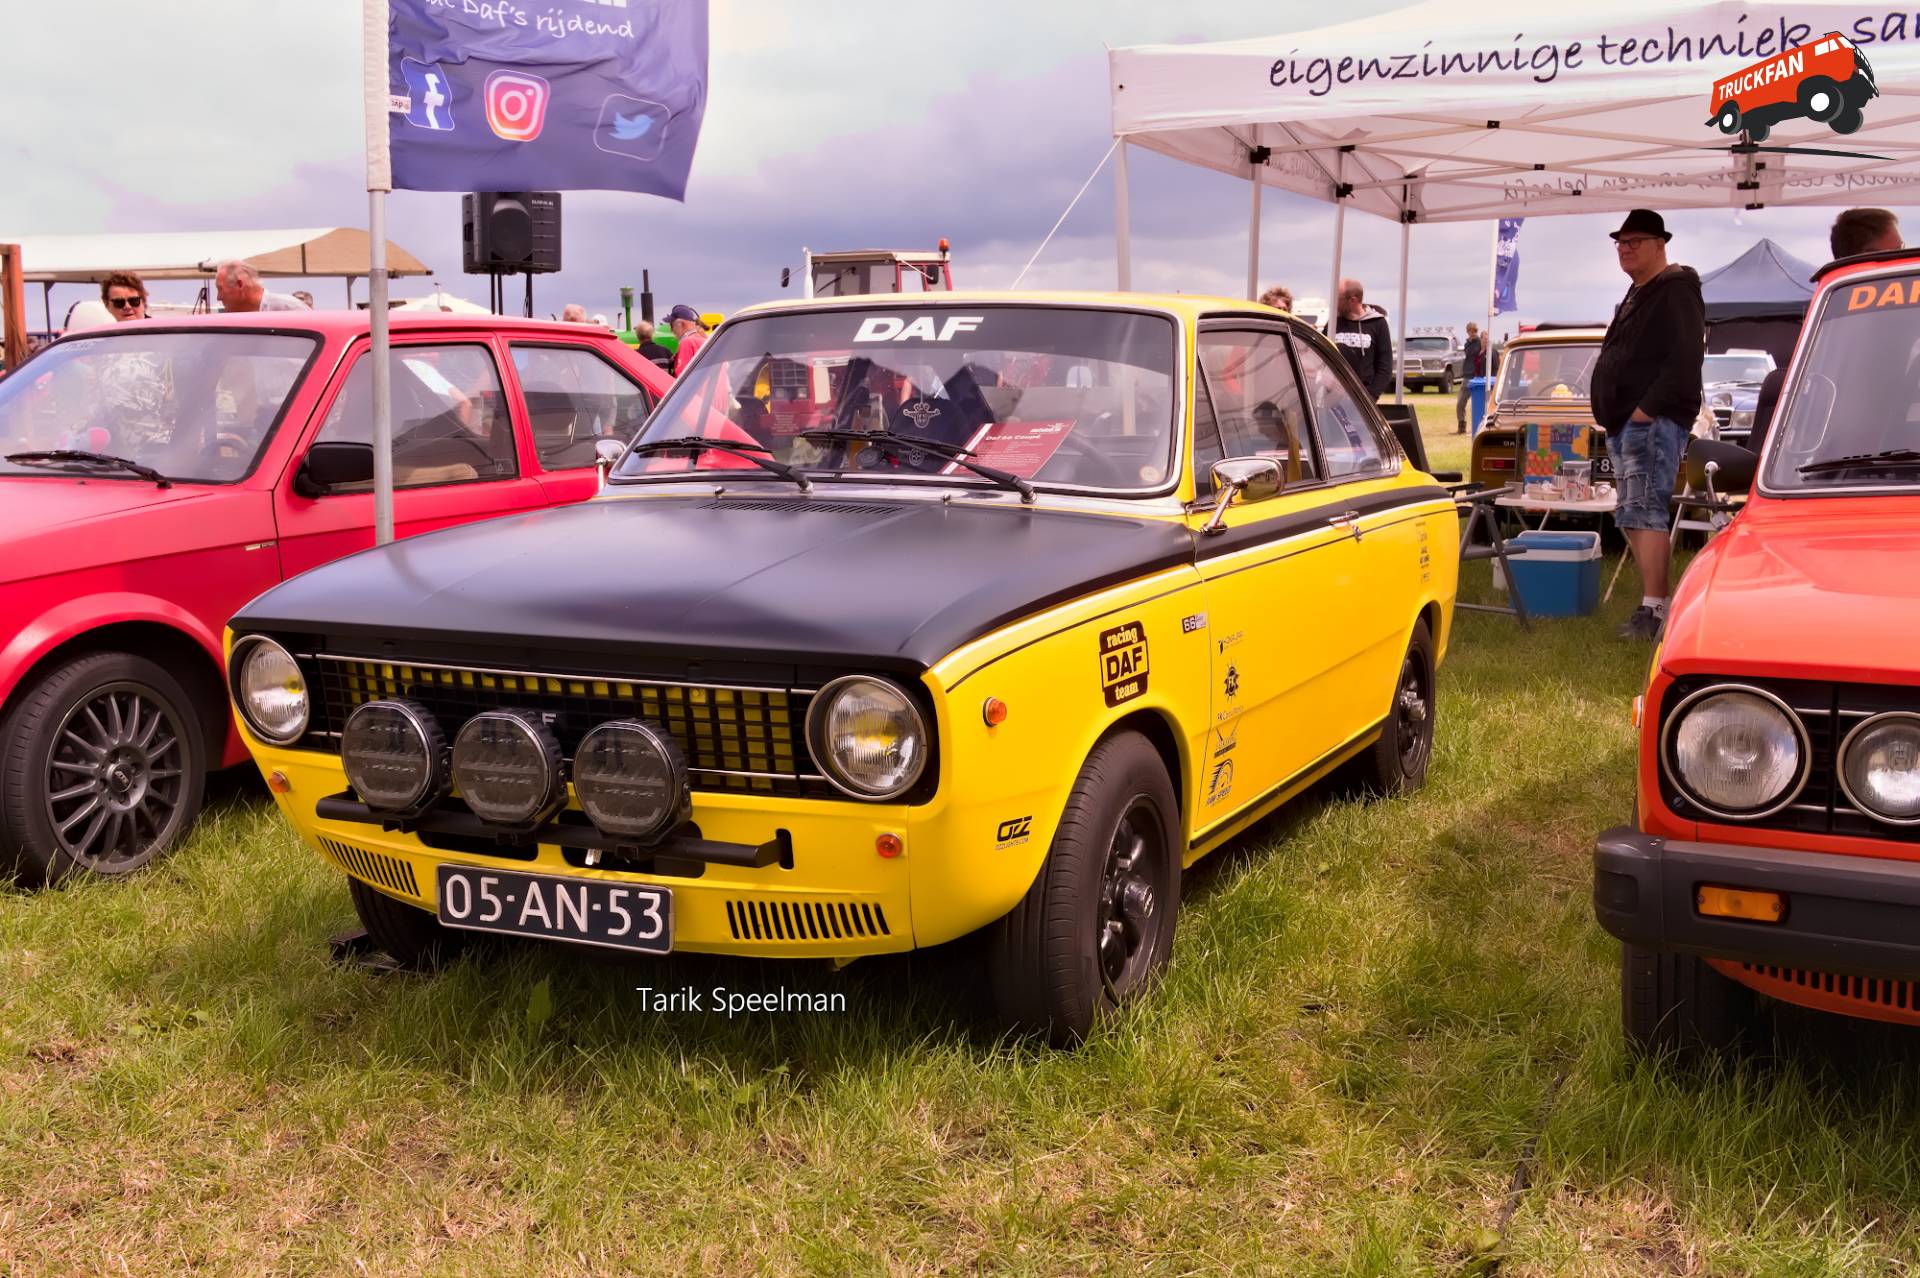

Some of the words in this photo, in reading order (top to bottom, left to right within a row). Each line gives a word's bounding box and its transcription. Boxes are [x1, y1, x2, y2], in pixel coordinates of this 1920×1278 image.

[464, 0, 528, 28] Daf's
[537, 8, 634, 38] rijdend
[1270, 33, 1583, 96] eigenzinnige
[1597, 14, 1811, 66] techniek
[853, 316, 984, 342] DAF
[1107, 625, 1138, 649] racing
[1106, 646, 1142, 682] DAF
[1114, 681, 1139, 700] team
